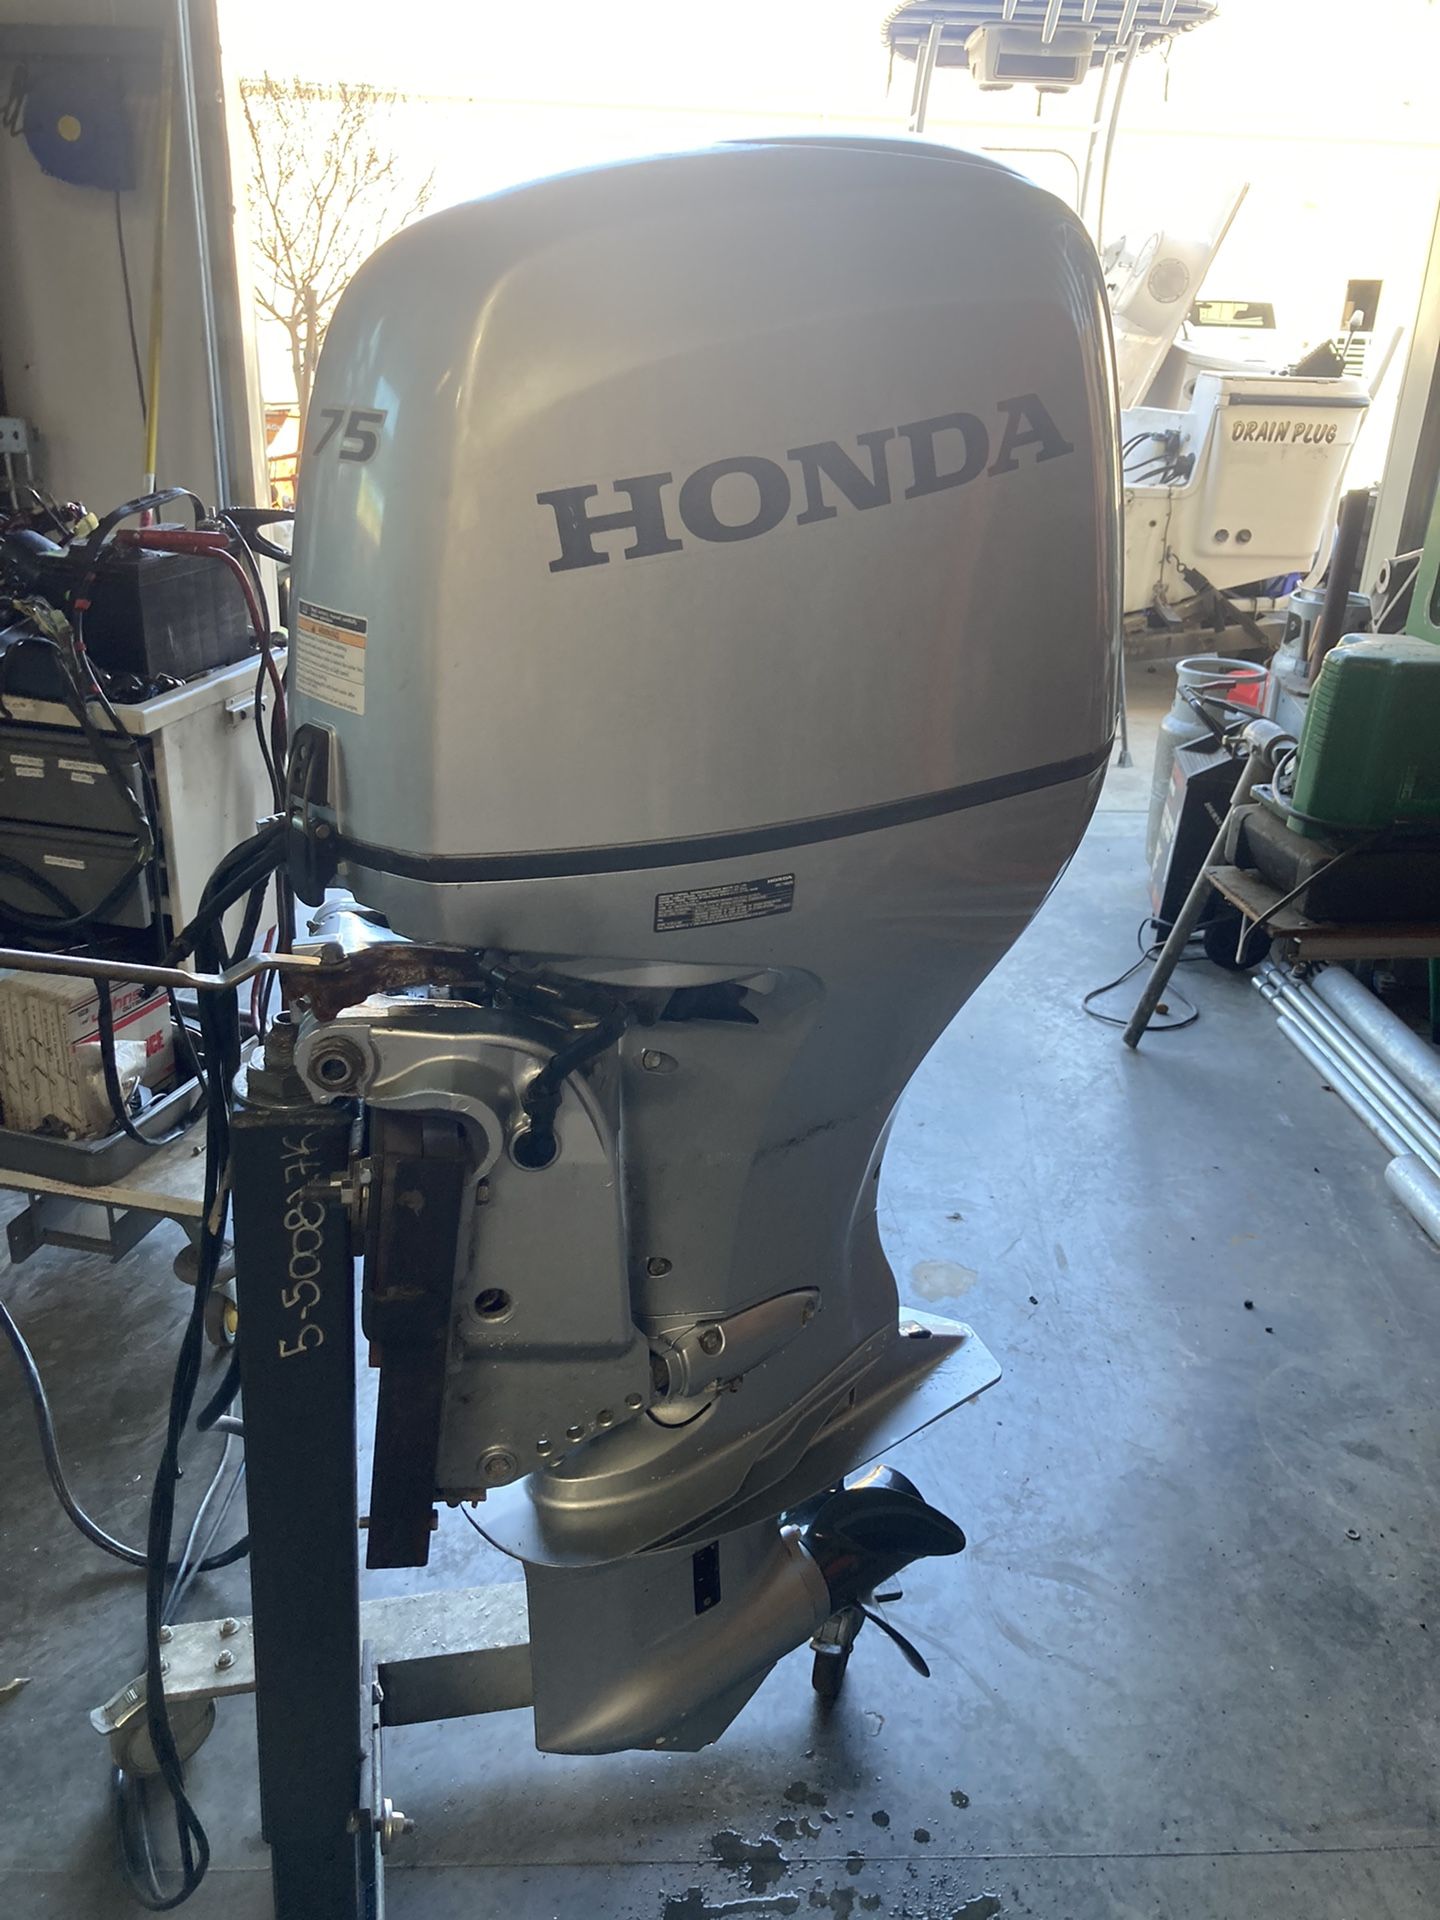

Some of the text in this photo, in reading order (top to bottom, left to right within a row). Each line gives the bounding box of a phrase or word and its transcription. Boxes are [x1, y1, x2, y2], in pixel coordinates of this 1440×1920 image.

[312, 407, 387, 463] 75
[1231, 420, 1338, 444] DRAIN PLUG
[536, 392, 1075, 574] HONDA
